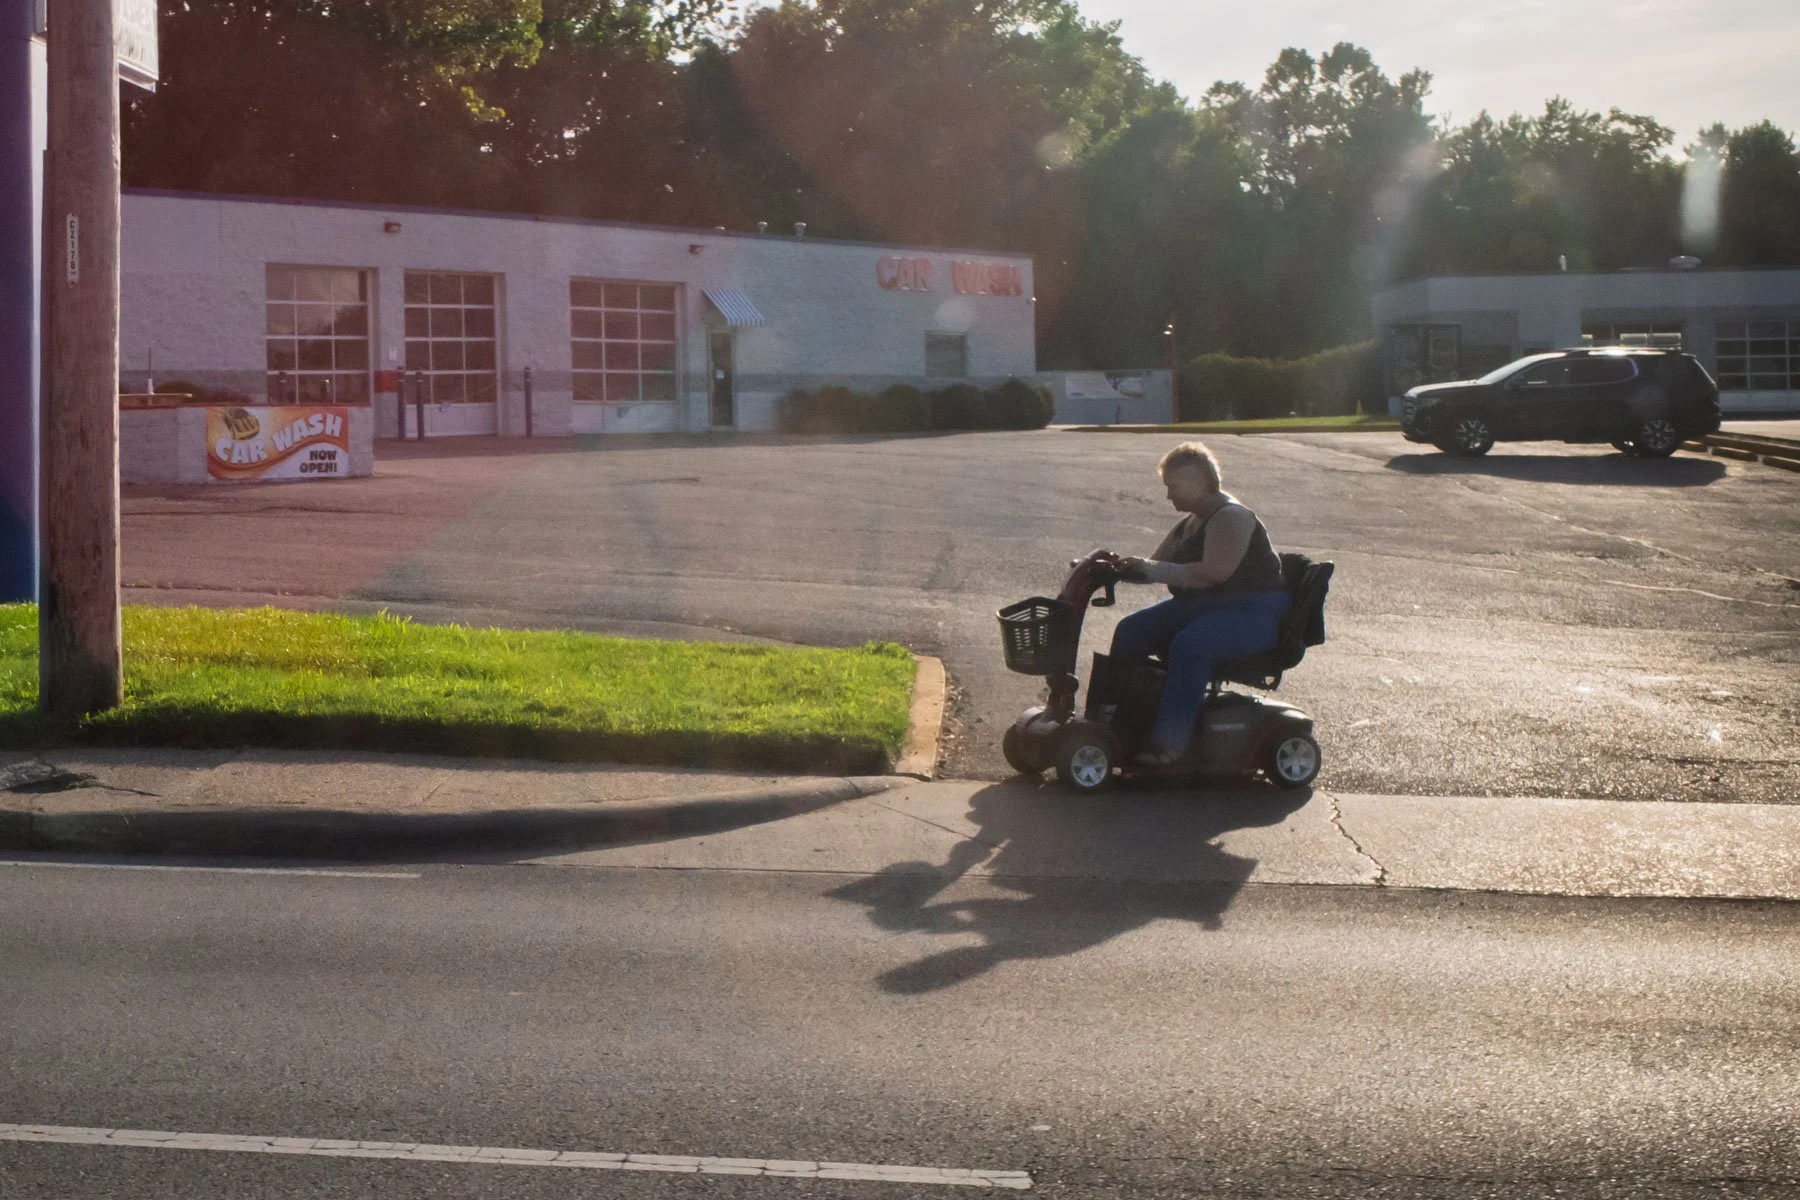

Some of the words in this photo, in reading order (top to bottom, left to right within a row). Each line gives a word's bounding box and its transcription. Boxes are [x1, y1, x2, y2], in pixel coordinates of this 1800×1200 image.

[876, 257, 932, 291] CAR
[215, 437, 267, 464] CAR
[271, 412, 342, 452] WASH
[309, 450, 337, 461] NOW
[300, 462, 338, 474] OPEN!
